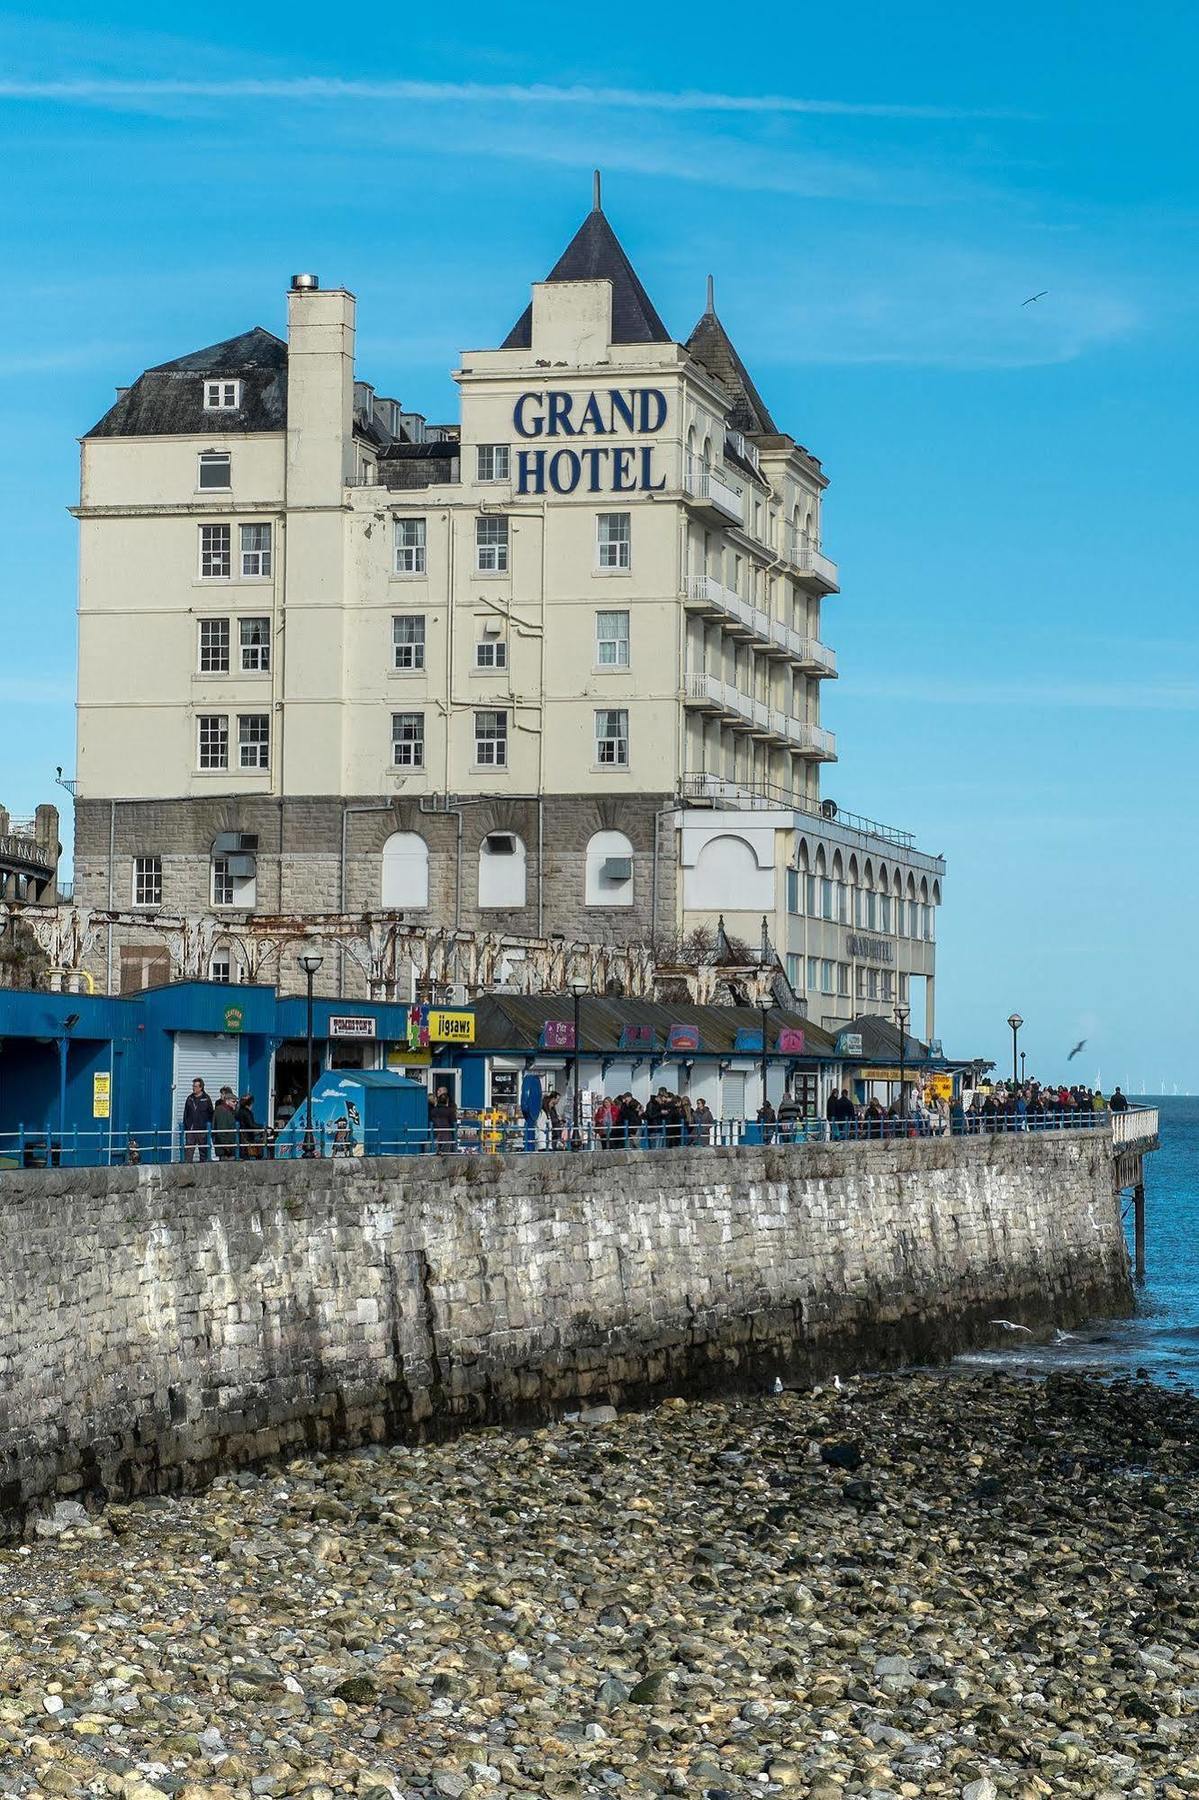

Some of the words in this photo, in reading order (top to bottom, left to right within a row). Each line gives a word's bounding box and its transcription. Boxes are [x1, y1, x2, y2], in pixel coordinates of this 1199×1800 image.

[513, 389, 667, 438] GRAND
[516, 447, 667, 495] HOTEL
[438, 1015, 470, 1036] jigsaws
